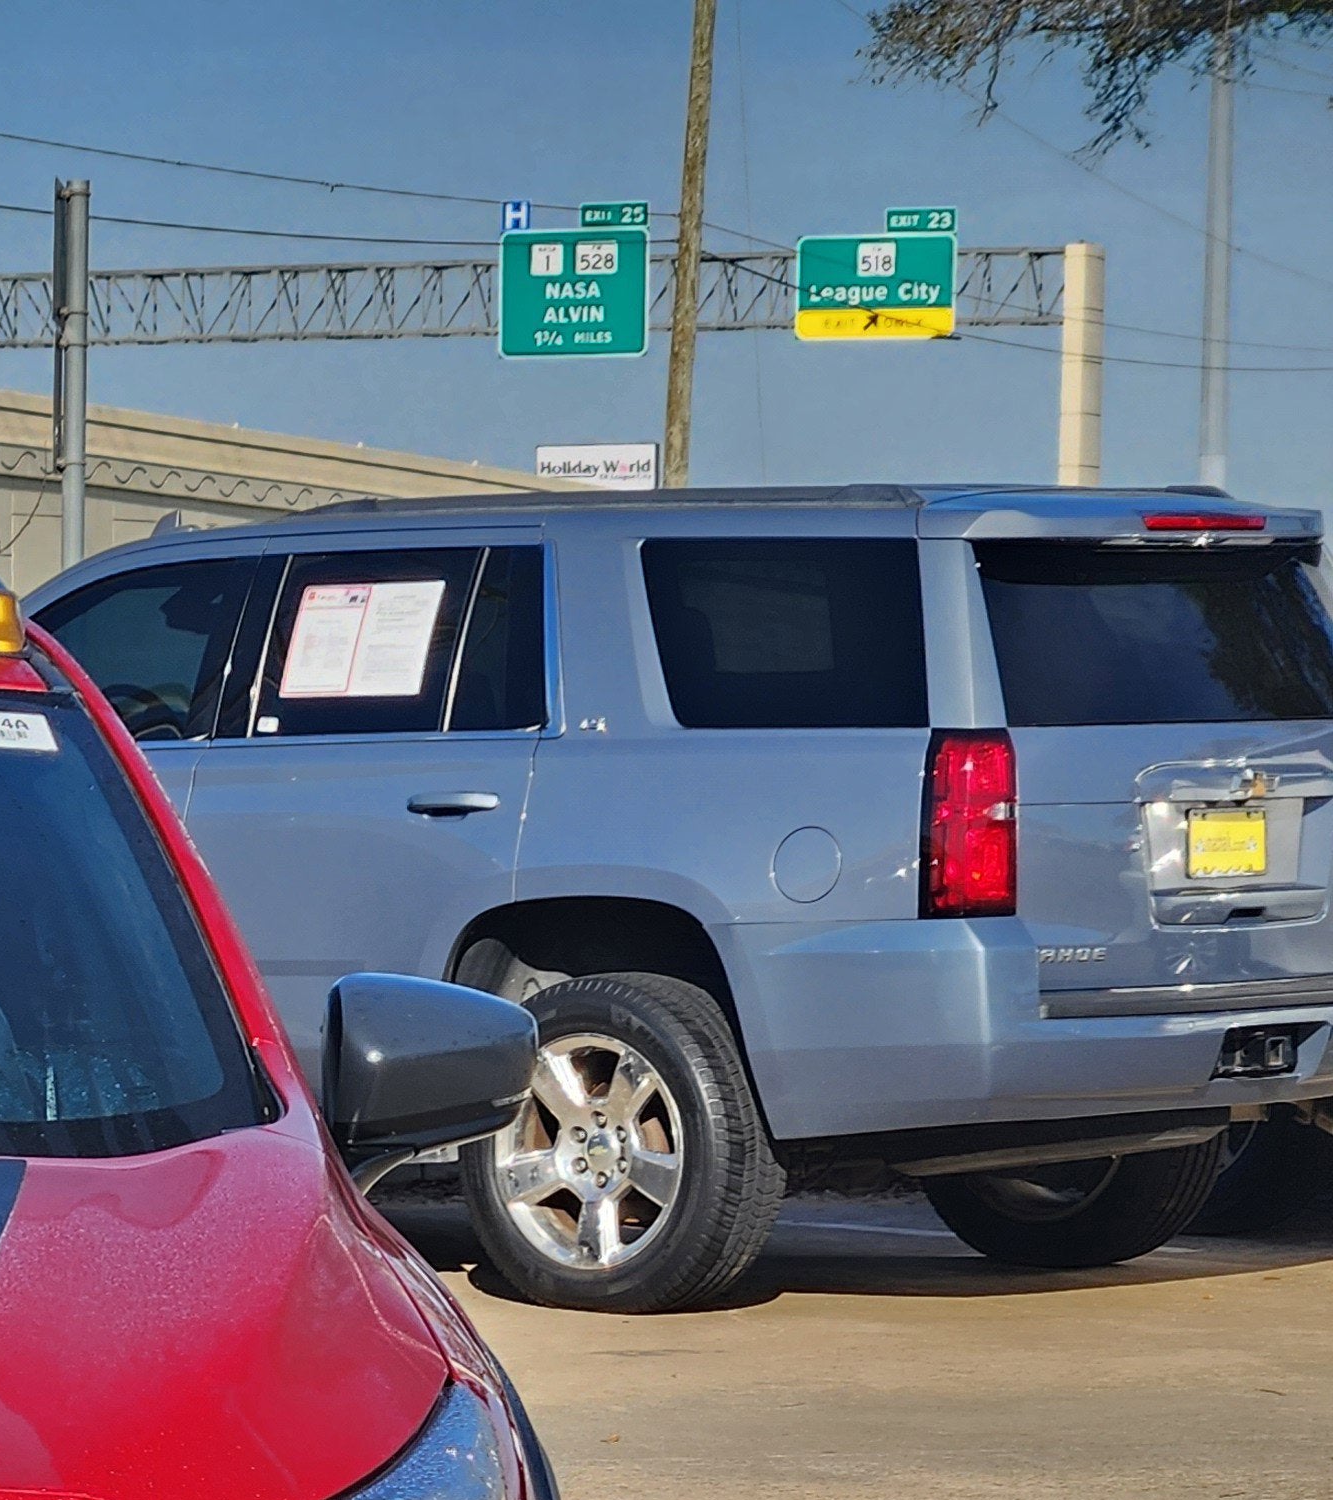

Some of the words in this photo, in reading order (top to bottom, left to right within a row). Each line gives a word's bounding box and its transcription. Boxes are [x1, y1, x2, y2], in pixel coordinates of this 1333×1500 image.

[505, 202, 527, 229] H
[584, 210, 612, 222] EXIT
[620, 206, 645, 224] 25
[889, 214, 920, 228] EXIT
[927, 211, 953, 229] 23
[545, 255, 551, 272] 1
[580, 253, 615, 271] 528
[861, 255, 893, 272] 518
[545, 281, 601, 300] NASA
[809, 284, 888, 306] League
[897, 281, 941, 304] City
[543, 305, 605, 324] ALVIN
[574, 331, 613, 344] MILES
[540, 461, 600, 477] Holiday
[1035, 947, 1107, 963] AHOE
